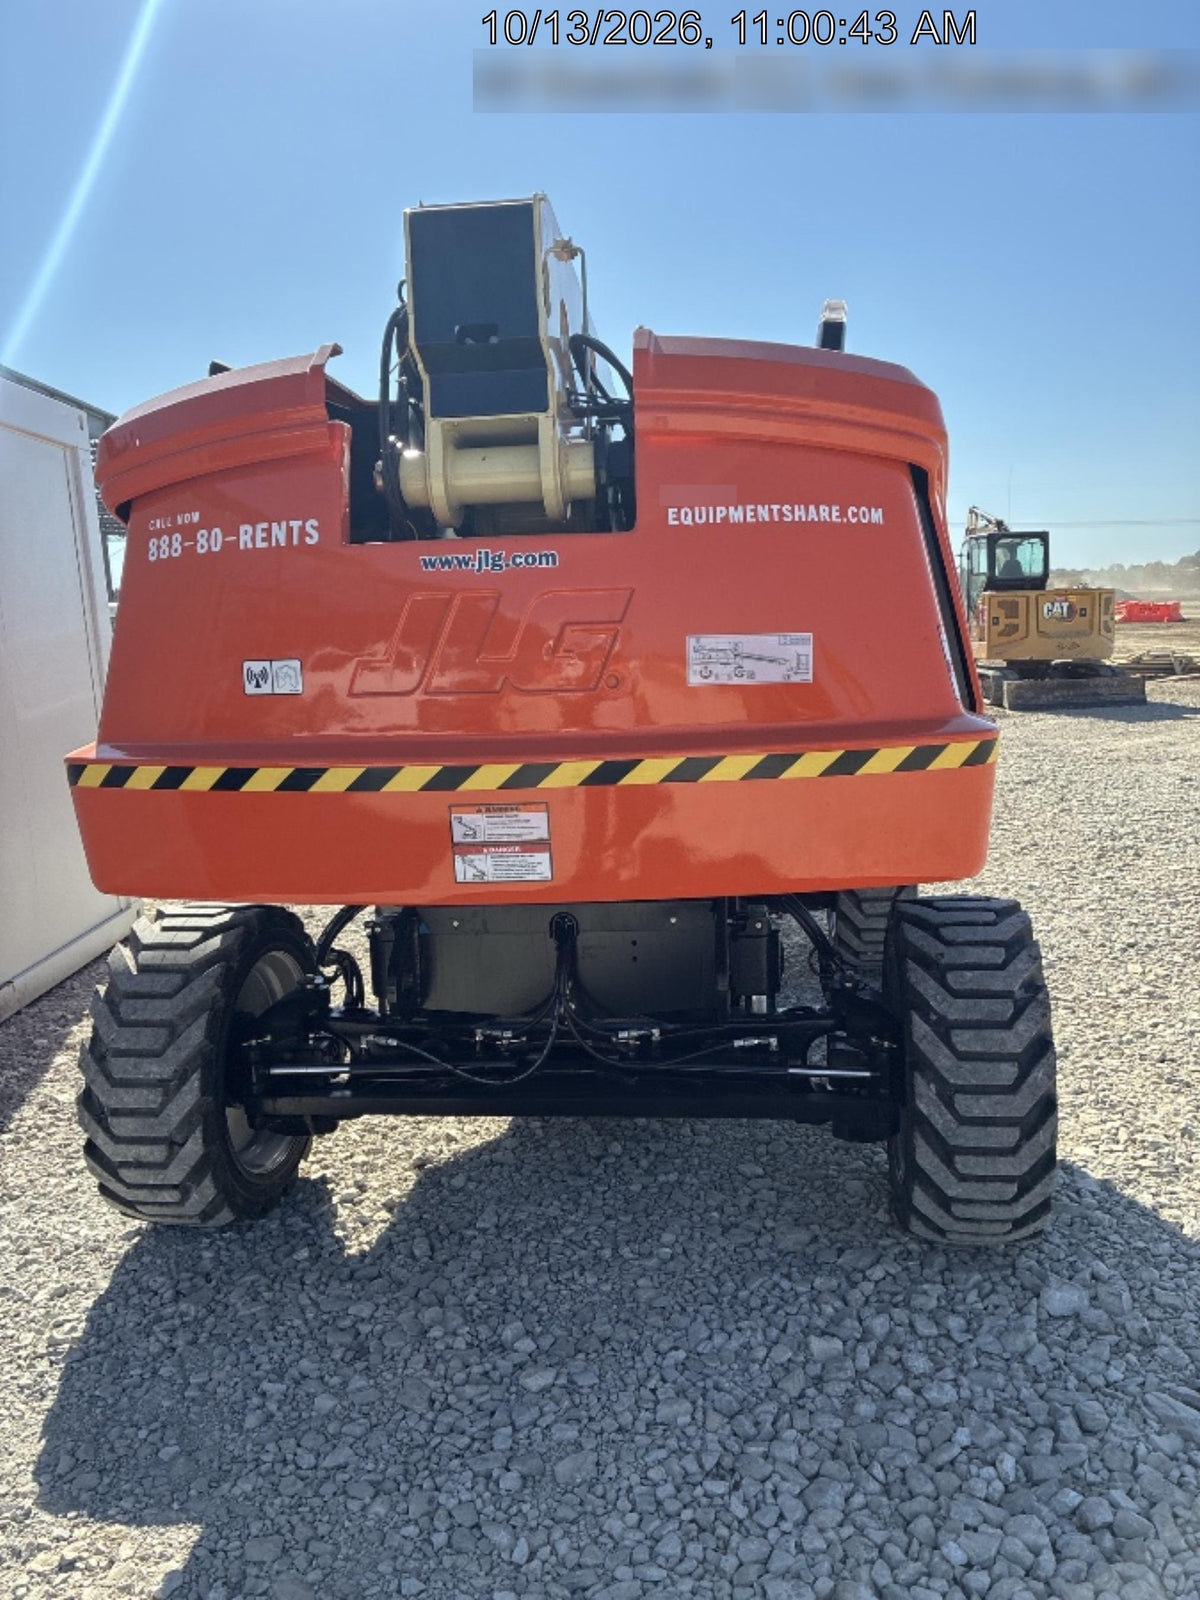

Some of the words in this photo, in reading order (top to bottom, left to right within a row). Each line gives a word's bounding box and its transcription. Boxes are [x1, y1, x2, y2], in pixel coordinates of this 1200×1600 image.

[176, 511, 200, 525] NOW
[667, 503, 884, 526] EQUIPMENTSHARE.COM
[148, 518, 320, 562] 888-80-RENTS
[420, 549, 559, 574] www.jlg.com
[1043, 602, 1069, 619] CAT
